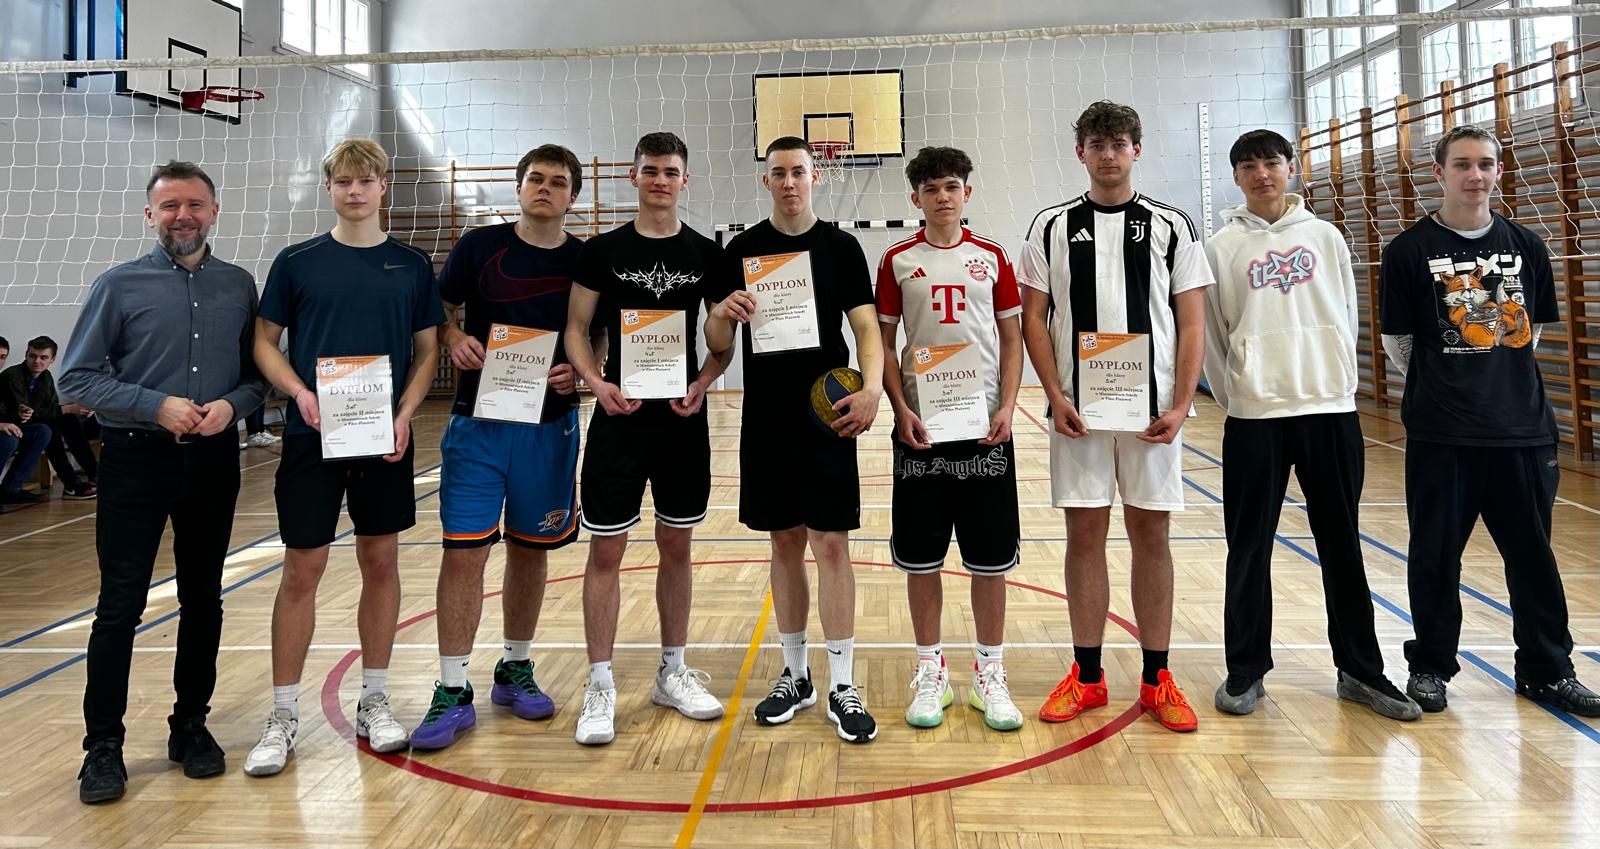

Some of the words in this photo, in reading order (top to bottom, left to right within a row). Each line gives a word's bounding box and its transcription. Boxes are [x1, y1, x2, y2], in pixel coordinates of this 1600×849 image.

[1428, 253, 1522, 282] ラーメン
[756, 279, 807, 292] DYPLOM
[631, 335, 680, 343] DYPLOM
[496, 351, 546, 365] DYPLOM
[1090, 361, 1142, 370] DYPLOM
[926, 370, 976, 382] DYPLOM
[329, 383, 383, 395] DYPLOM
[893, 449, 927, 479] Los
